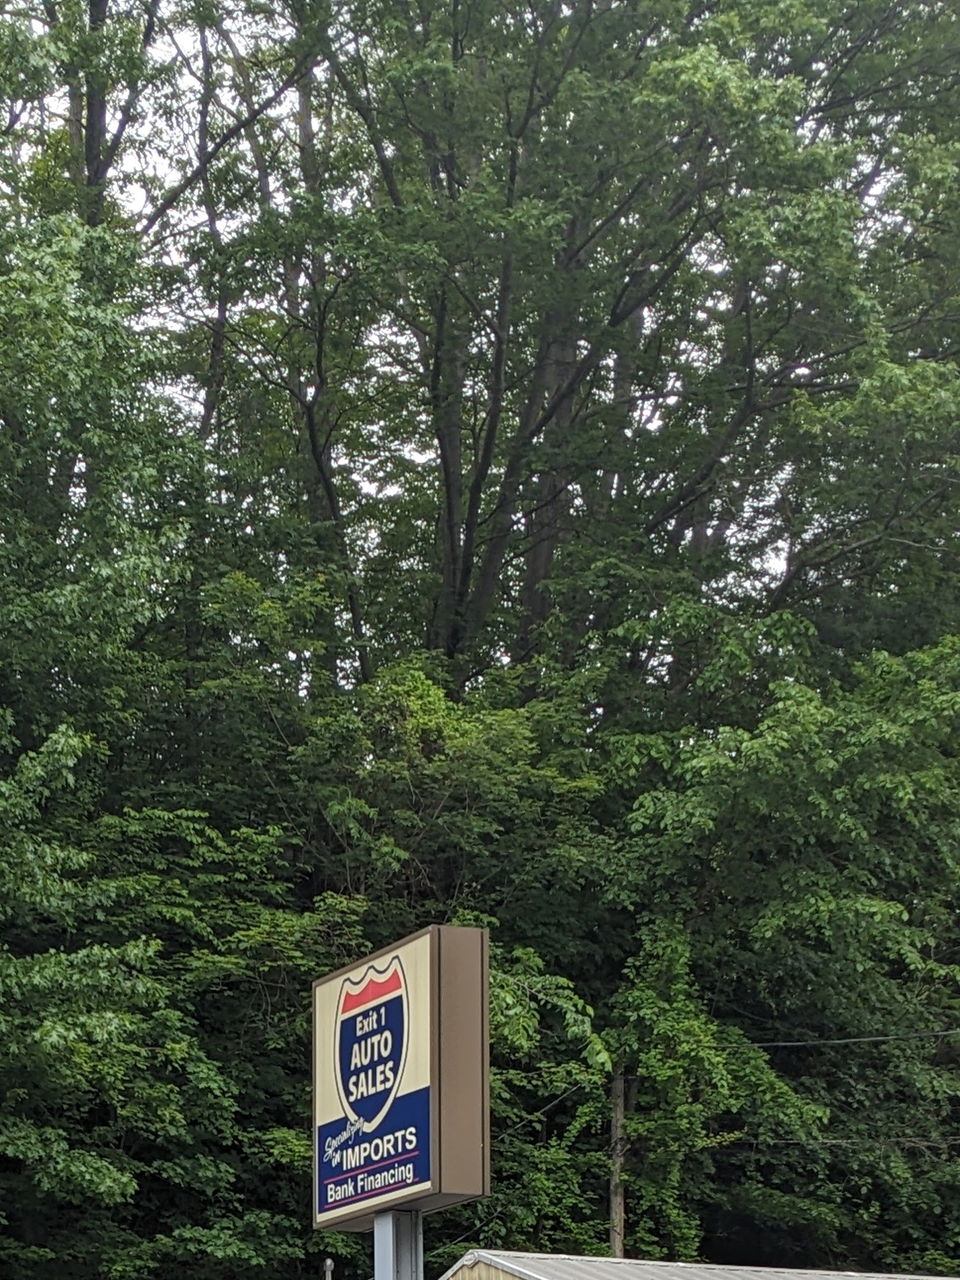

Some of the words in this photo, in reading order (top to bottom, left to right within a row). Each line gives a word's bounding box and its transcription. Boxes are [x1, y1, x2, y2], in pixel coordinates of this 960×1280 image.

[356, 1010, 378, 1037] Exit
[380, 1006, 386, 1026] 1
[350, 1030, 392, 1071] AUTO
[348, 1060, 394, 1102] SALES
[343, 1127, 417, 1171] IMPORTS
[327, 1178, 355, 1203] Bank
[357, 1163, 414, 1193] Financing
